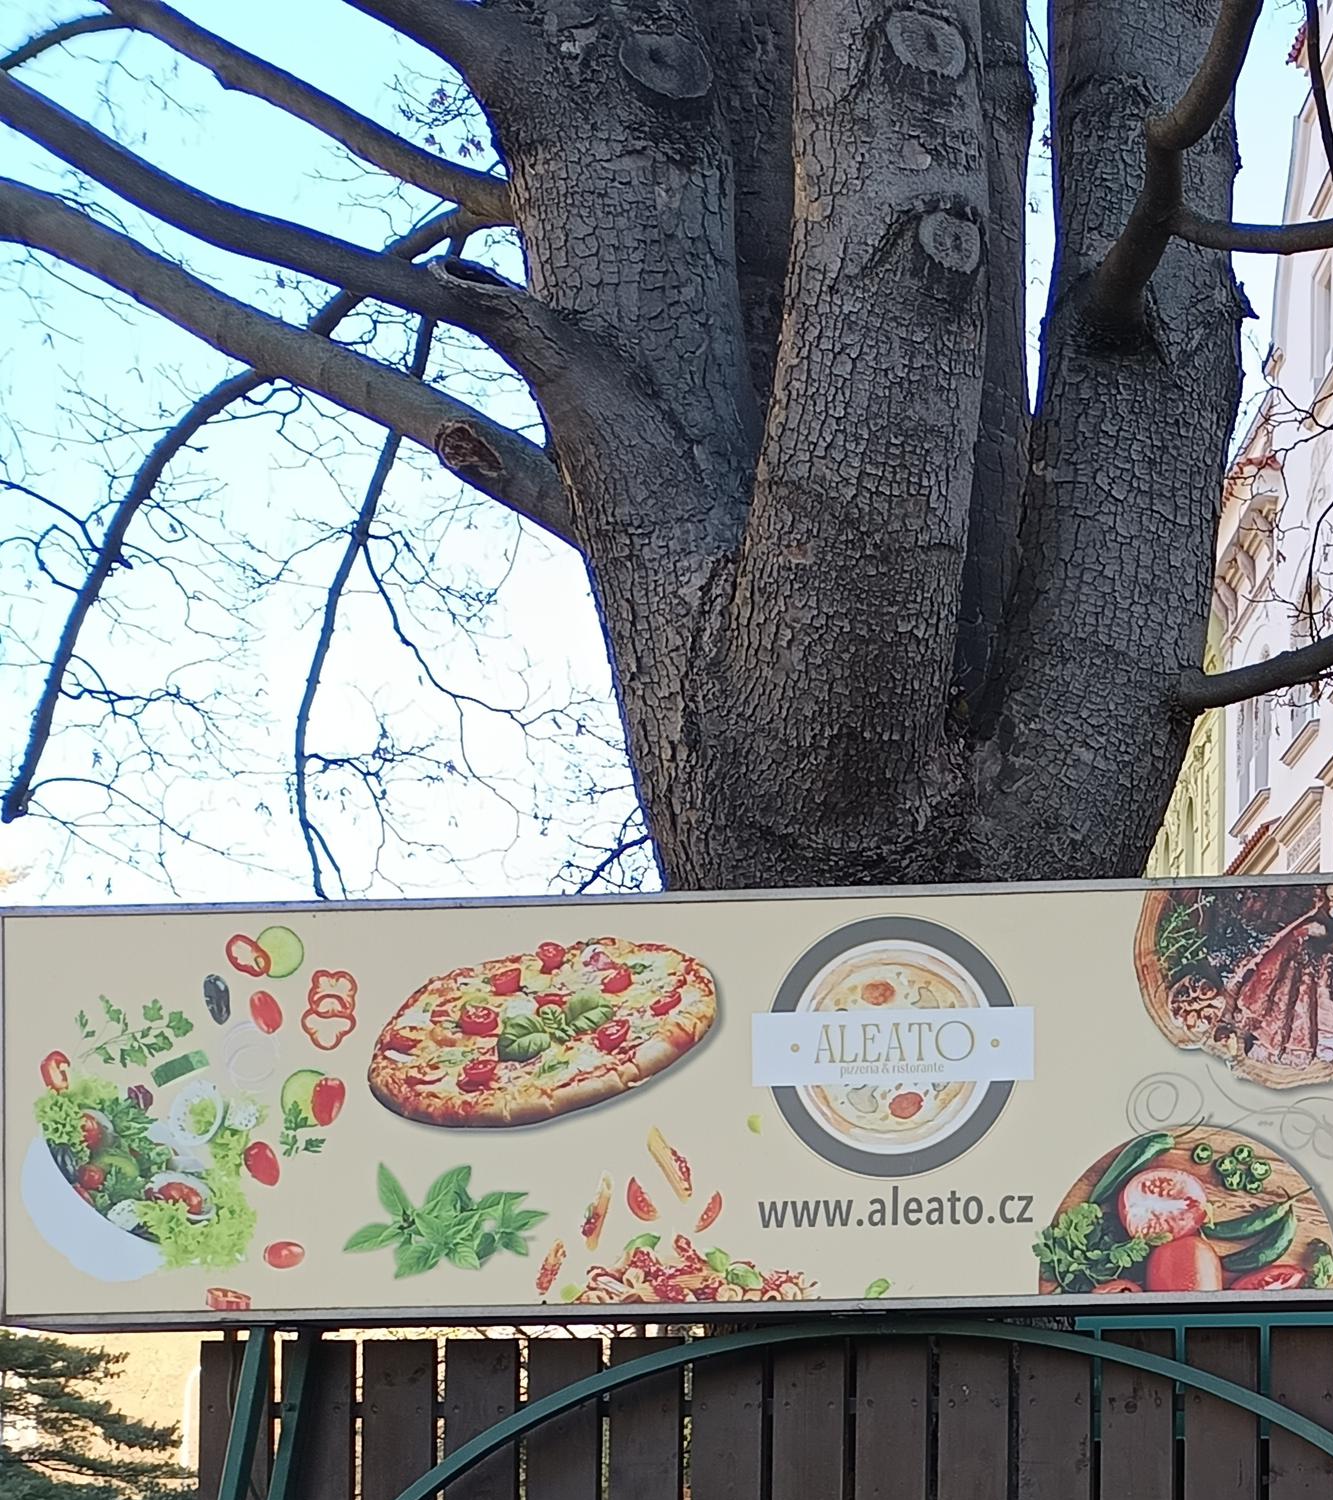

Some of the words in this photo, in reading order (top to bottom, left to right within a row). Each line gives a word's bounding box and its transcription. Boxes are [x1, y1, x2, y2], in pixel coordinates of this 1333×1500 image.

[813, 1020, 976, 1064] ALEATO
[840, 1063, 879, 1079] pizzeria
[881, 1063, 890, 1074] &
[892, 1062, 944, 1074] ristorante
[758, 1186, 1034, 1229] www.aleato.cz
